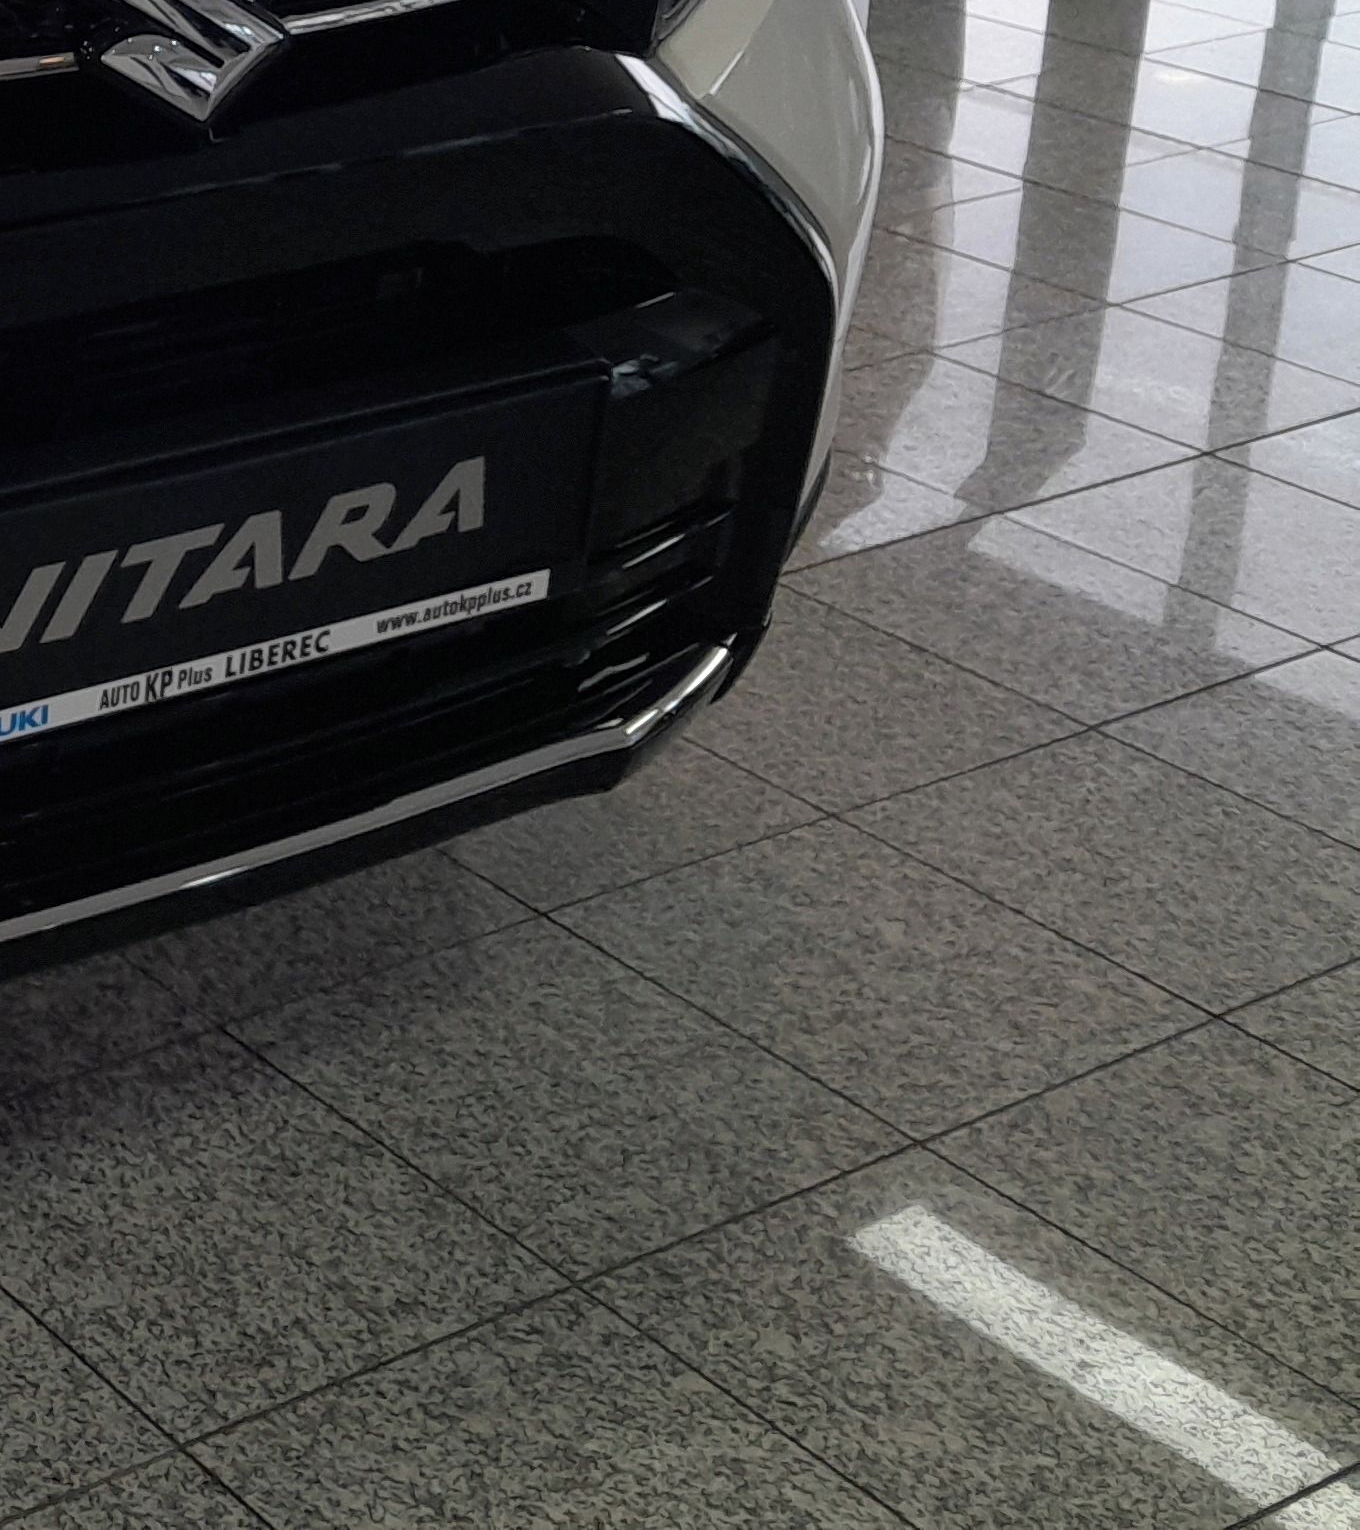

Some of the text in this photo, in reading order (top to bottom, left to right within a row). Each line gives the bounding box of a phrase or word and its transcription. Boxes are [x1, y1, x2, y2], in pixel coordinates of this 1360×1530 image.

[98, 680, 141, 711] AUTO
[144, 667, 174, 704] KP
[176, 665, 214, 690] Plus
[224, 629, 332, 679] LIBEREC
[375, 580, 534, 634] www.autokpplus.cz
